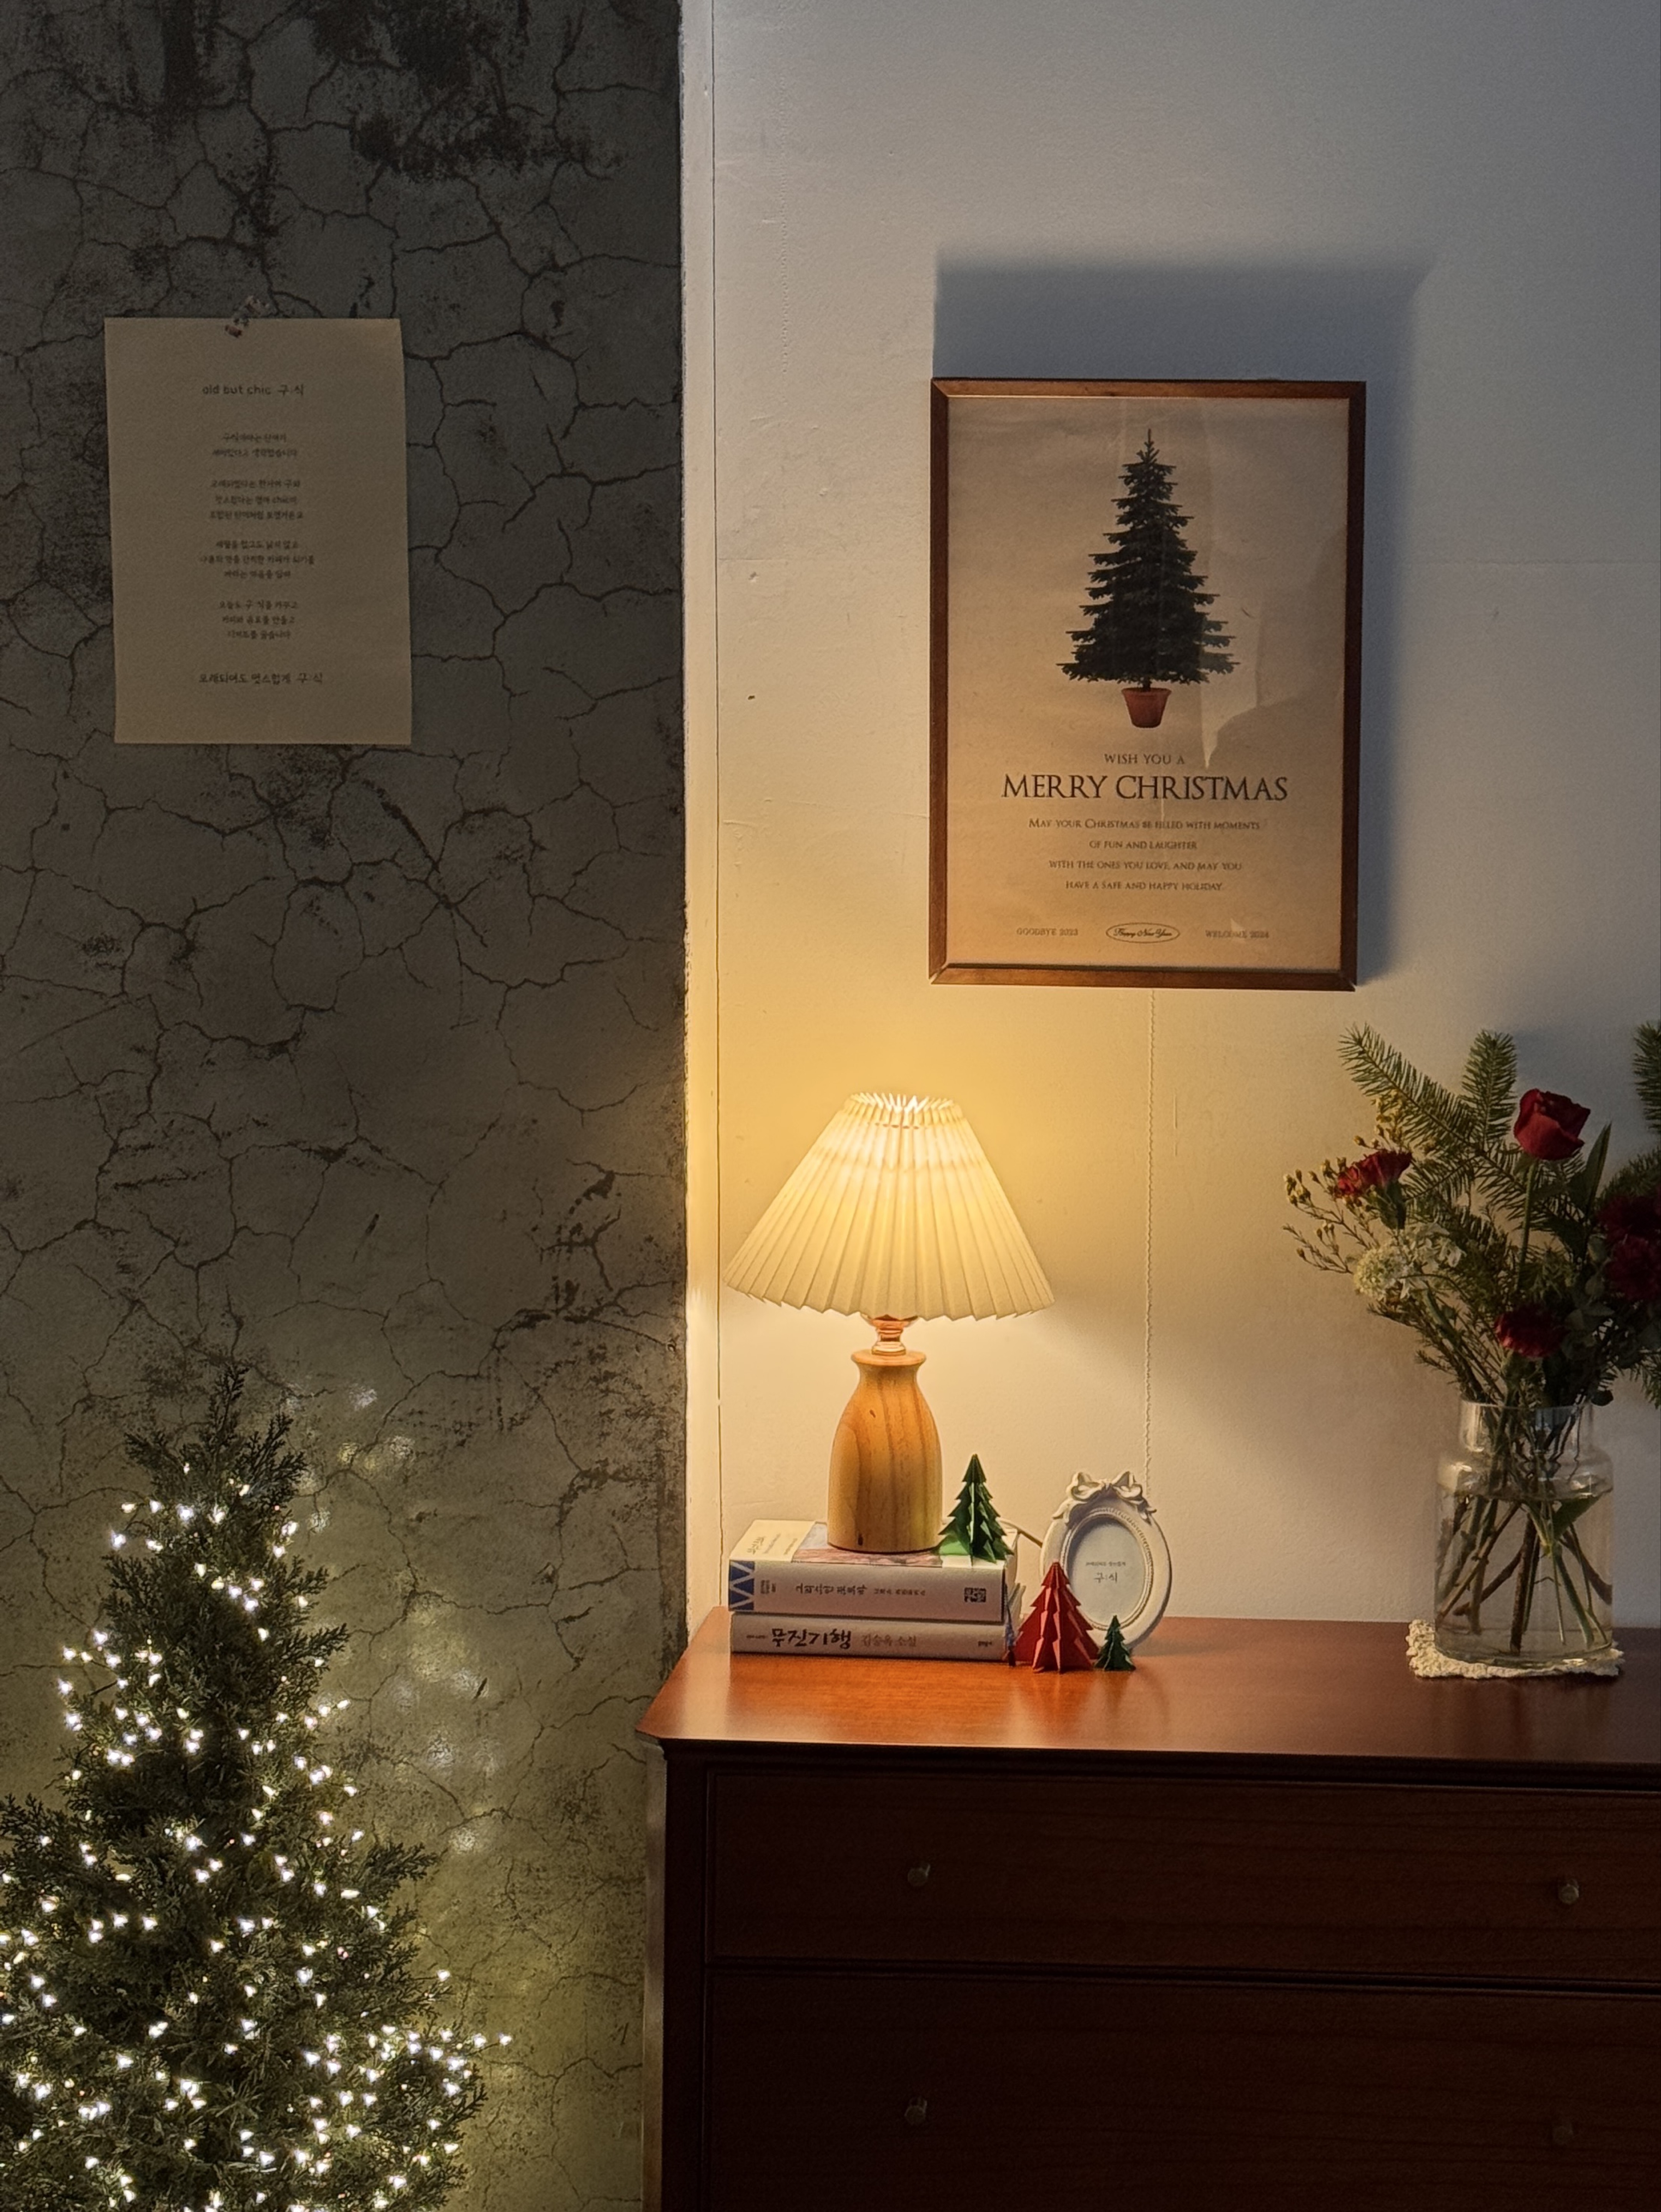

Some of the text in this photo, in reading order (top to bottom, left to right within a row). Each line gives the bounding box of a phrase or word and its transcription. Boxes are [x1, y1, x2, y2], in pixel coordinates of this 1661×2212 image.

[202, 384, 219, 395] old
[223, 385, 243, 395] but
[246, 384, 271, 395] chic
[199, 672, 248, 684] 오래되어도
[1104, 753, 1185, 765] WISH YOU A
[1001, 774, 1288, 801] MERRY CHRISTMAS
[1089, 840, 1197, 850] OF FUN AND LAUGHTER
[1049, 860, 1074, 869] WITH
[1077, 860, 1094, 869] THE
[1096, 861, 1121, 869] ONES
[1124, 861, 1143, 869] YOU
[1173, 862, 1195, 870] AND
[1197, 862, 1218, 871] MAY
[1222, 862, 1242, 870] YOU
[1066, 881, 1089, 889] HAVE
[1092, 881, 1099, 889] A
[1102, 881, 1121, 889] SAFE
[1125, 881, 1146, 890] AND
[1149, 882, 1178, 890] HAPPY
[1016, 927, 1079, 936] GOODBYE 2023
[1205, 930, 1248, 939] WELCOME
[771, 1628, 917, 1650] 무진기행 김승옥 소설
